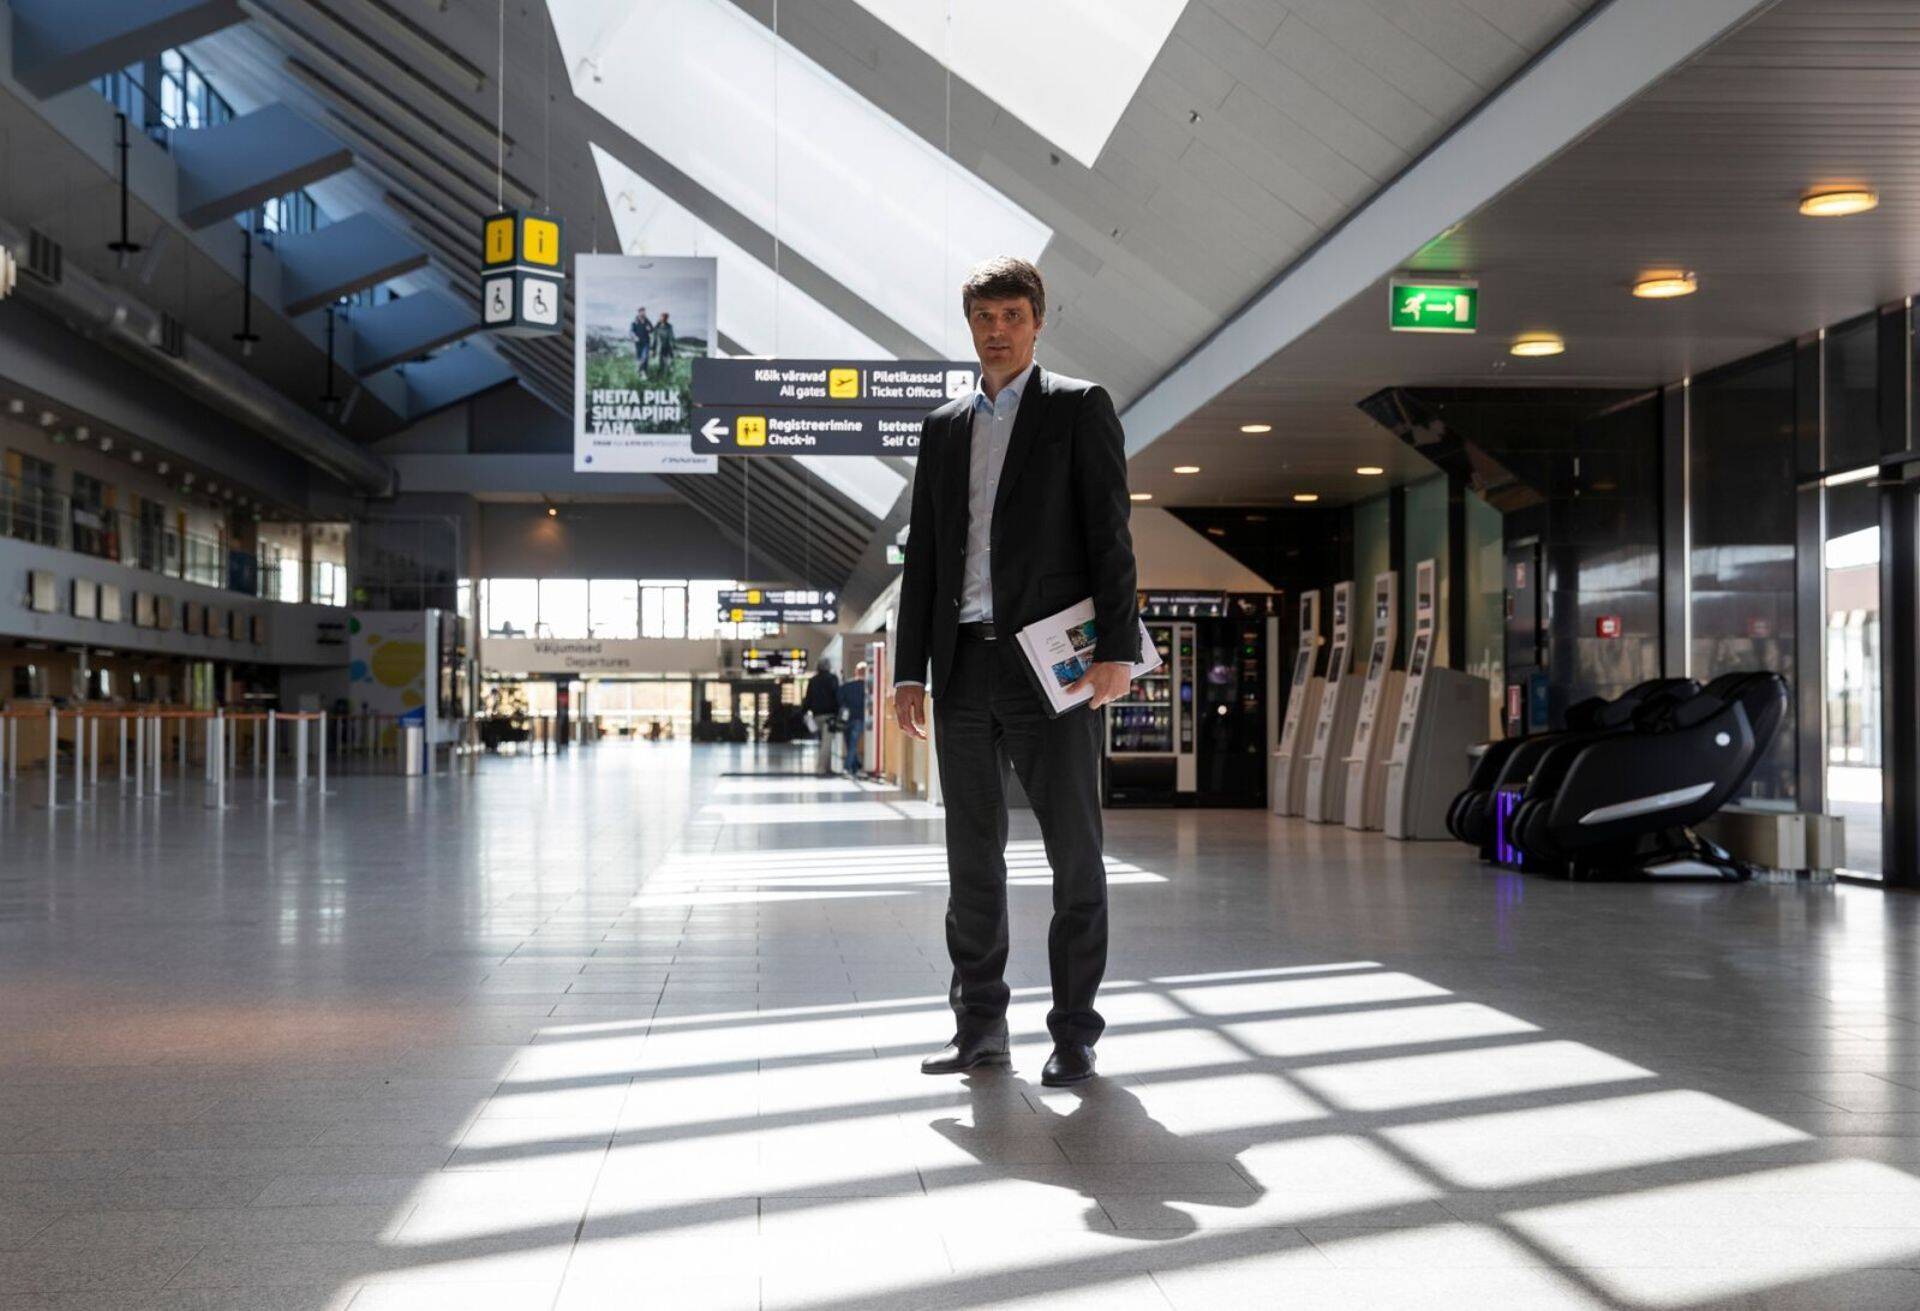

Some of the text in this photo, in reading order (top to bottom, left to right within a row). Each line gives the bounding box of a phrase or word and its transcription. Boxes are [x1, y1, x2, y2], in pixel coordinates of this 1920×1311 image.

[754, 369, 827, 383] Kõik väravad
[873, 370, 943, 384] Piletikassad
[592, 389, 681, 405] HEITA PILK
[779, 384, 826, 400] All gates
[871, 386, 943, 398] Ticket Offices
[592, 421, 636, 435] TAHA
[768, 418, 863, 433] Registreerimine
[878, 420, 924, 432] Iseteen
[768, 434, 817, 446] Check-in
[882, 435, 905, 447] Self
[565, 656, 630, 668] Departures
